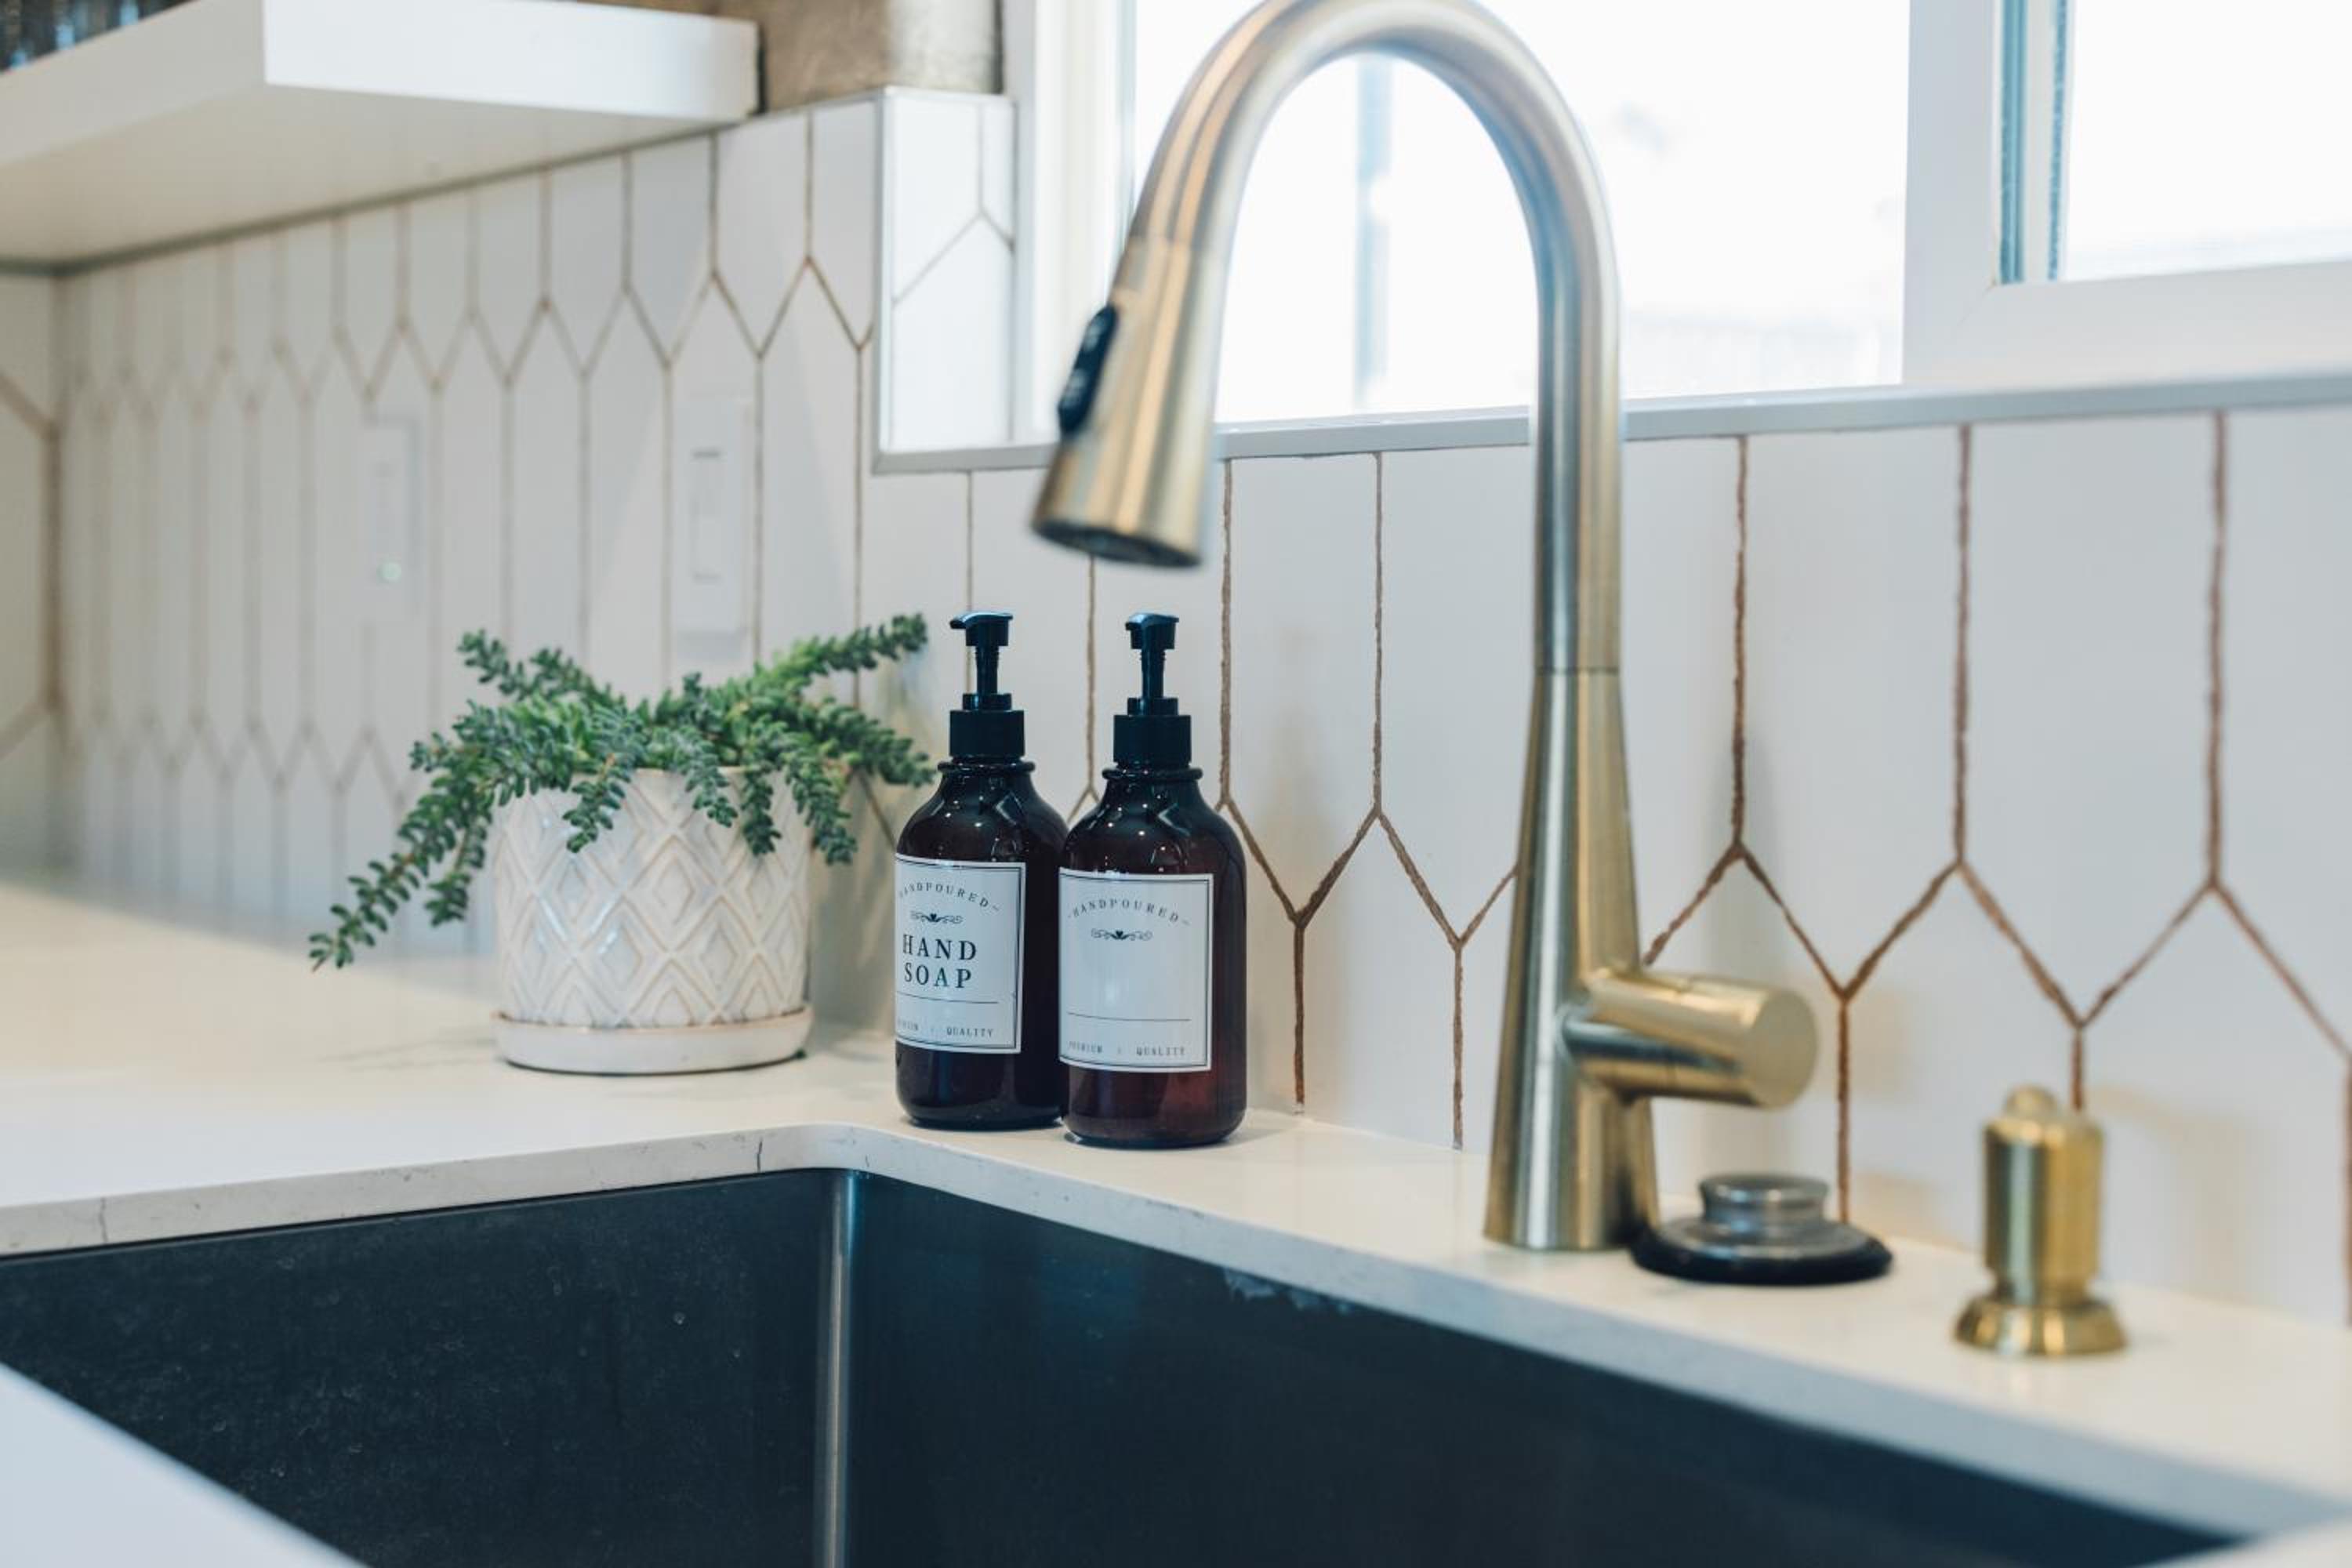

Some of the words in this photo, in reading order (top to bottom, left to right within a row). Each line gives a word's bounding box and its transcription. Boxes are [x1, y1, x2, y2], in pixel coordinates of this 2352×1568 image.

[1072, 898, 1179, 923] HANDPOURED
[902, 934, 976, 960] HAND
[905, 962, 971, 989] SOAP
